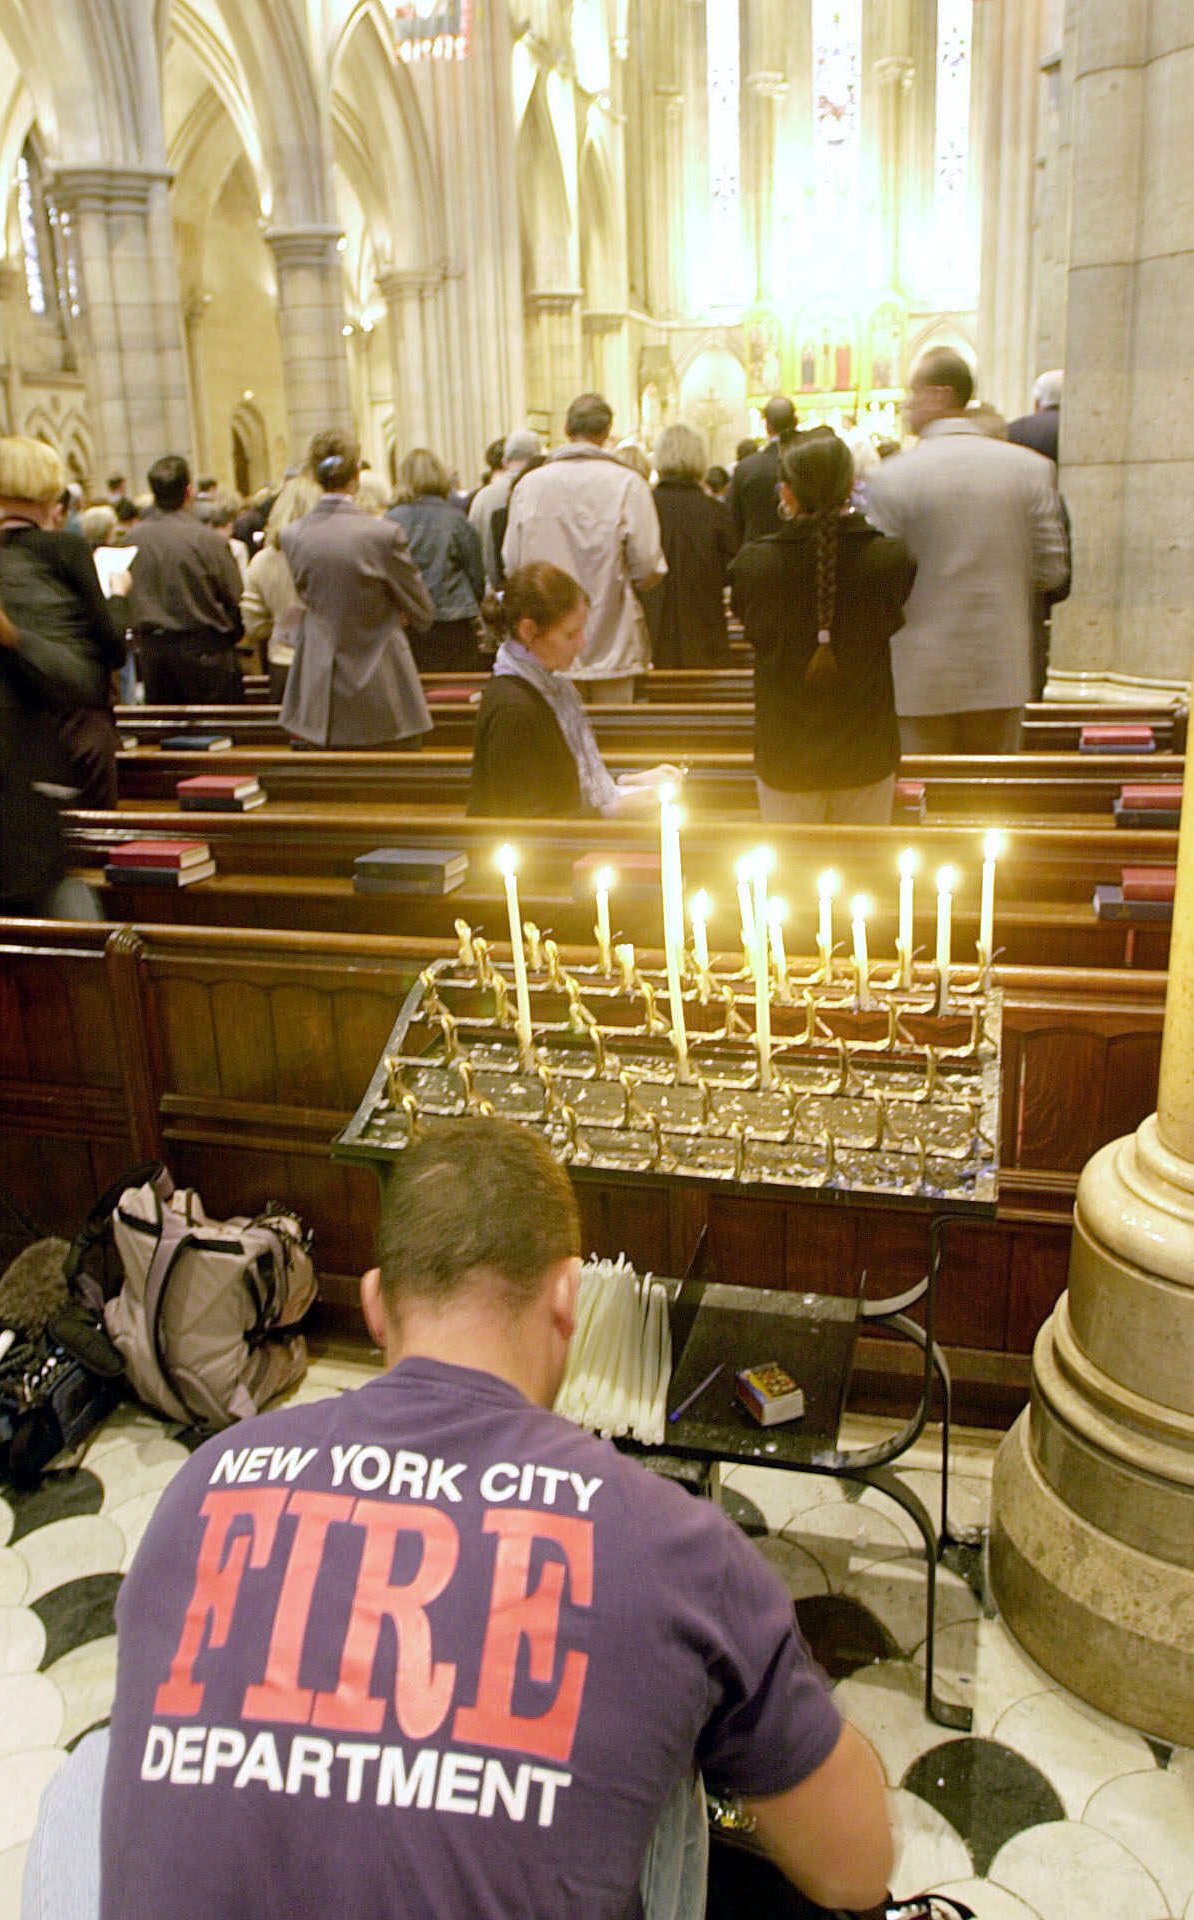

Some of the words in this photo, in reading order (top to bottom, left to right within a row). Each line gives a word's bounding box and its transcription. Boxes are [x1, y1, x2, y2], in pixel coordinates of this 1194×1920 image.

[209, 1446, 318, 1485] NEW
[330, 1444, 467, 1502] YORK
[479, 1462, 603, 1513] CITY
[153, 1487, 595, 1762] FIRE
[140, 1725, 572, 1827] DEPARTMENT
